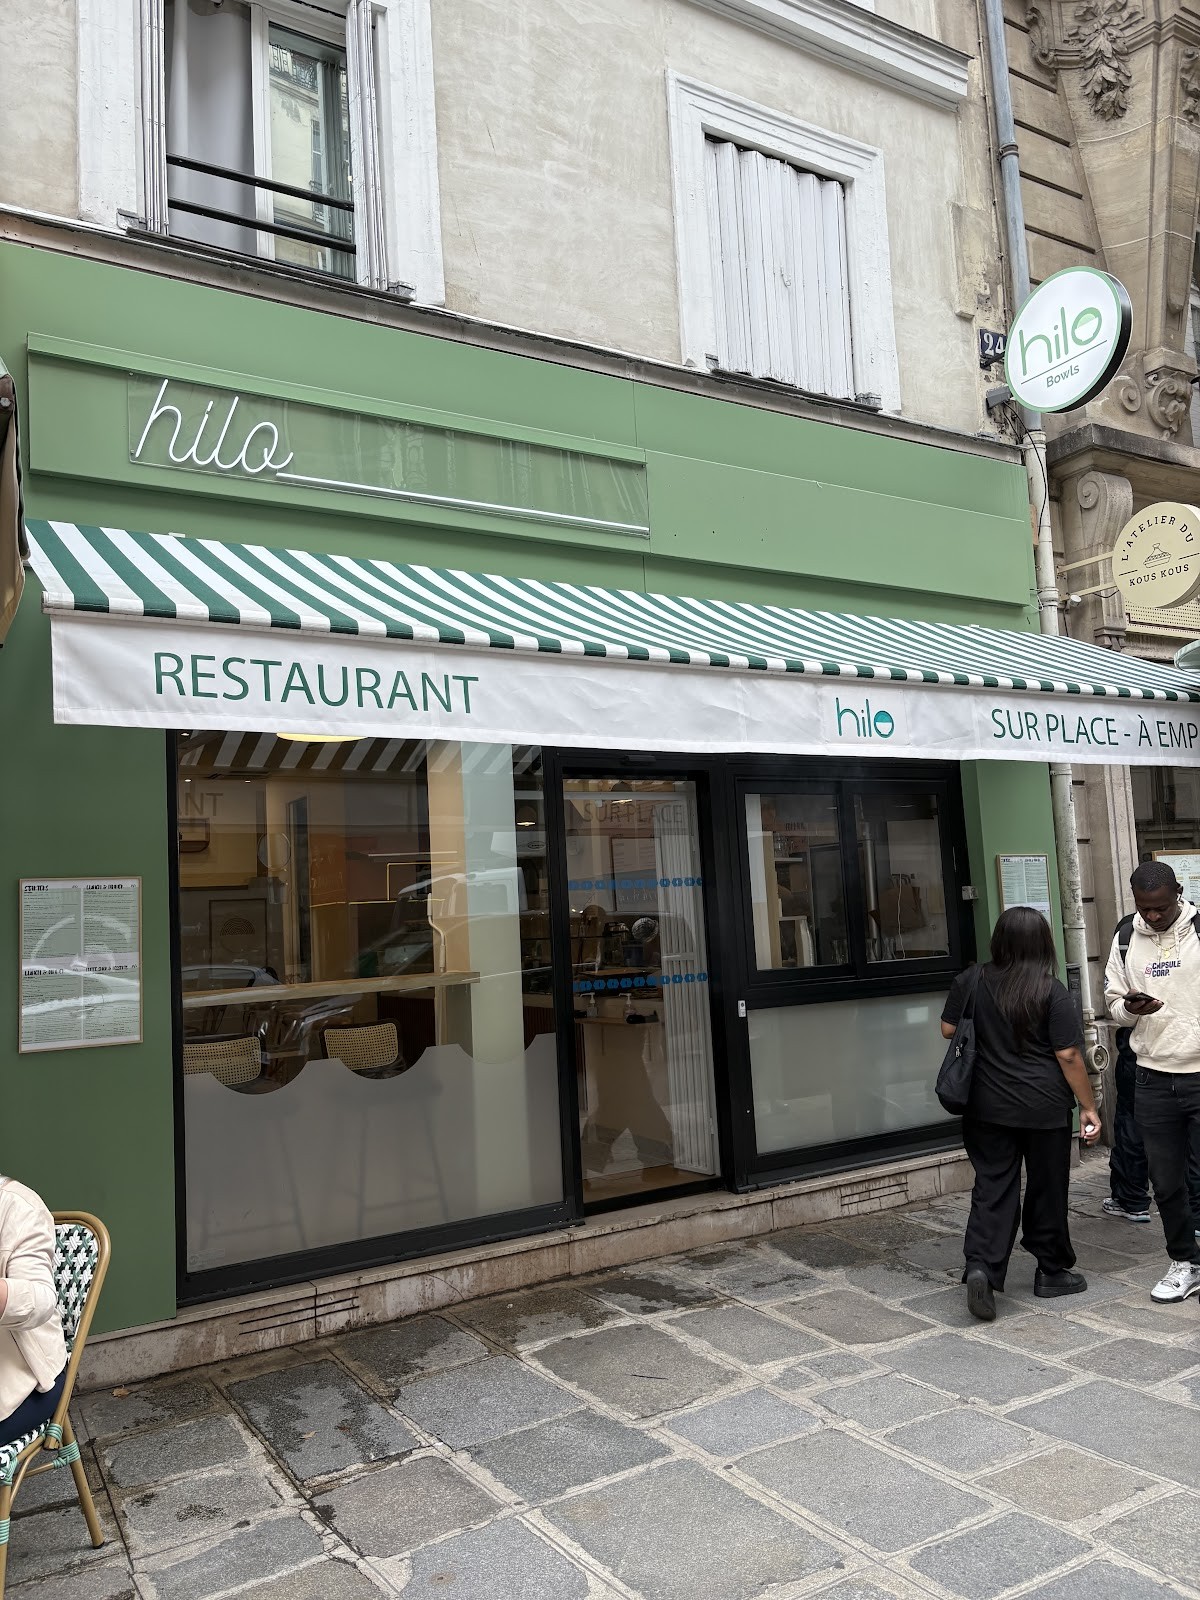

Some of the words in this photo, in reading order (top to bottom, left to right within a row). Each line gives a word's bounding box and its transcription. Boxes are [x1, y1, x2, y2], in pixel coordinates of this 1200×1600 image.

[983, 333, 1005, 356] 24
[1019, 307, 1102, 376] hilo
[1046, 364, 1080, 388] Bowls
[135, 378, 294, 473] hilo
[1122, 515, 1176, 561] L'ATELIER
[1179, 523, 1194, 543] DU
[1129, 572, 1157, 587] KOUS
[1160, 563, 1189, 579] KOUS
[154, 652, 479, 714] RESTAURANT
[835, 697, 895, 738] hilo
[991, 708, 1041, 741] SUR
[1046, 713, 1119, 746] PLACE
[1137, 714, 1153, 747] À
[1152, 960, 1181, 970] CAPSULE
[1152, 969, 1170, 978] CORP.
